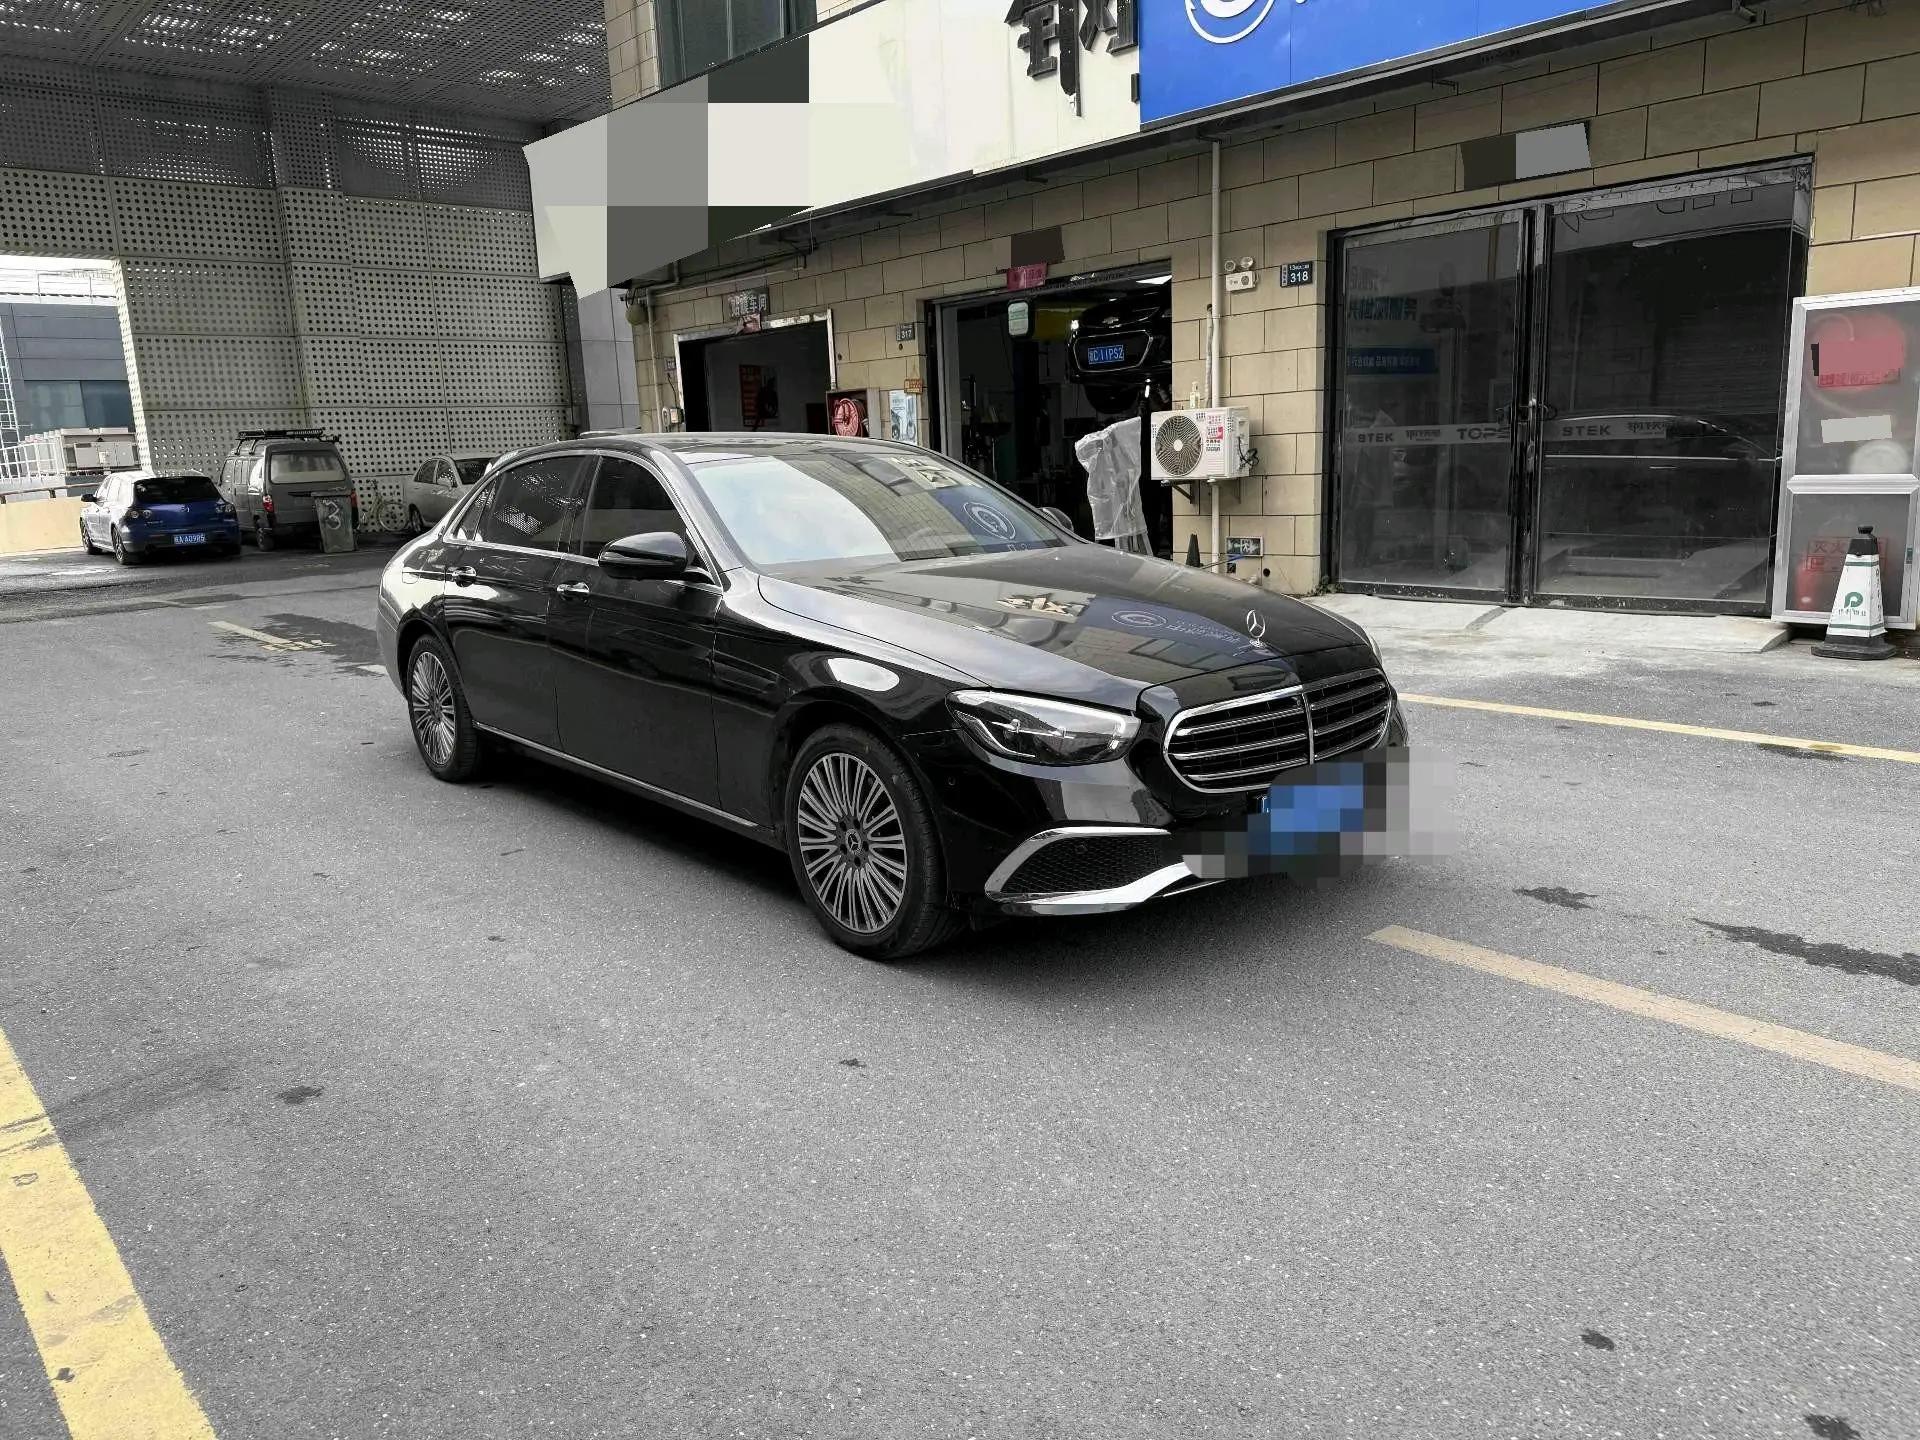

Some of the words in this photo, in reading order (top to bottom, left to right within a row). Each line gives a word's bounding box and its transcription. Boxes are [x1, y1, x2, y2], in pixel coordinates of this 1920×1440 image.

[1290, 271, 1309, 283] 318
[901, 329, 912, 339] 317
[1562, 425, 1611, 437] STEK
[1358, 432, 1394, 443] STEK
